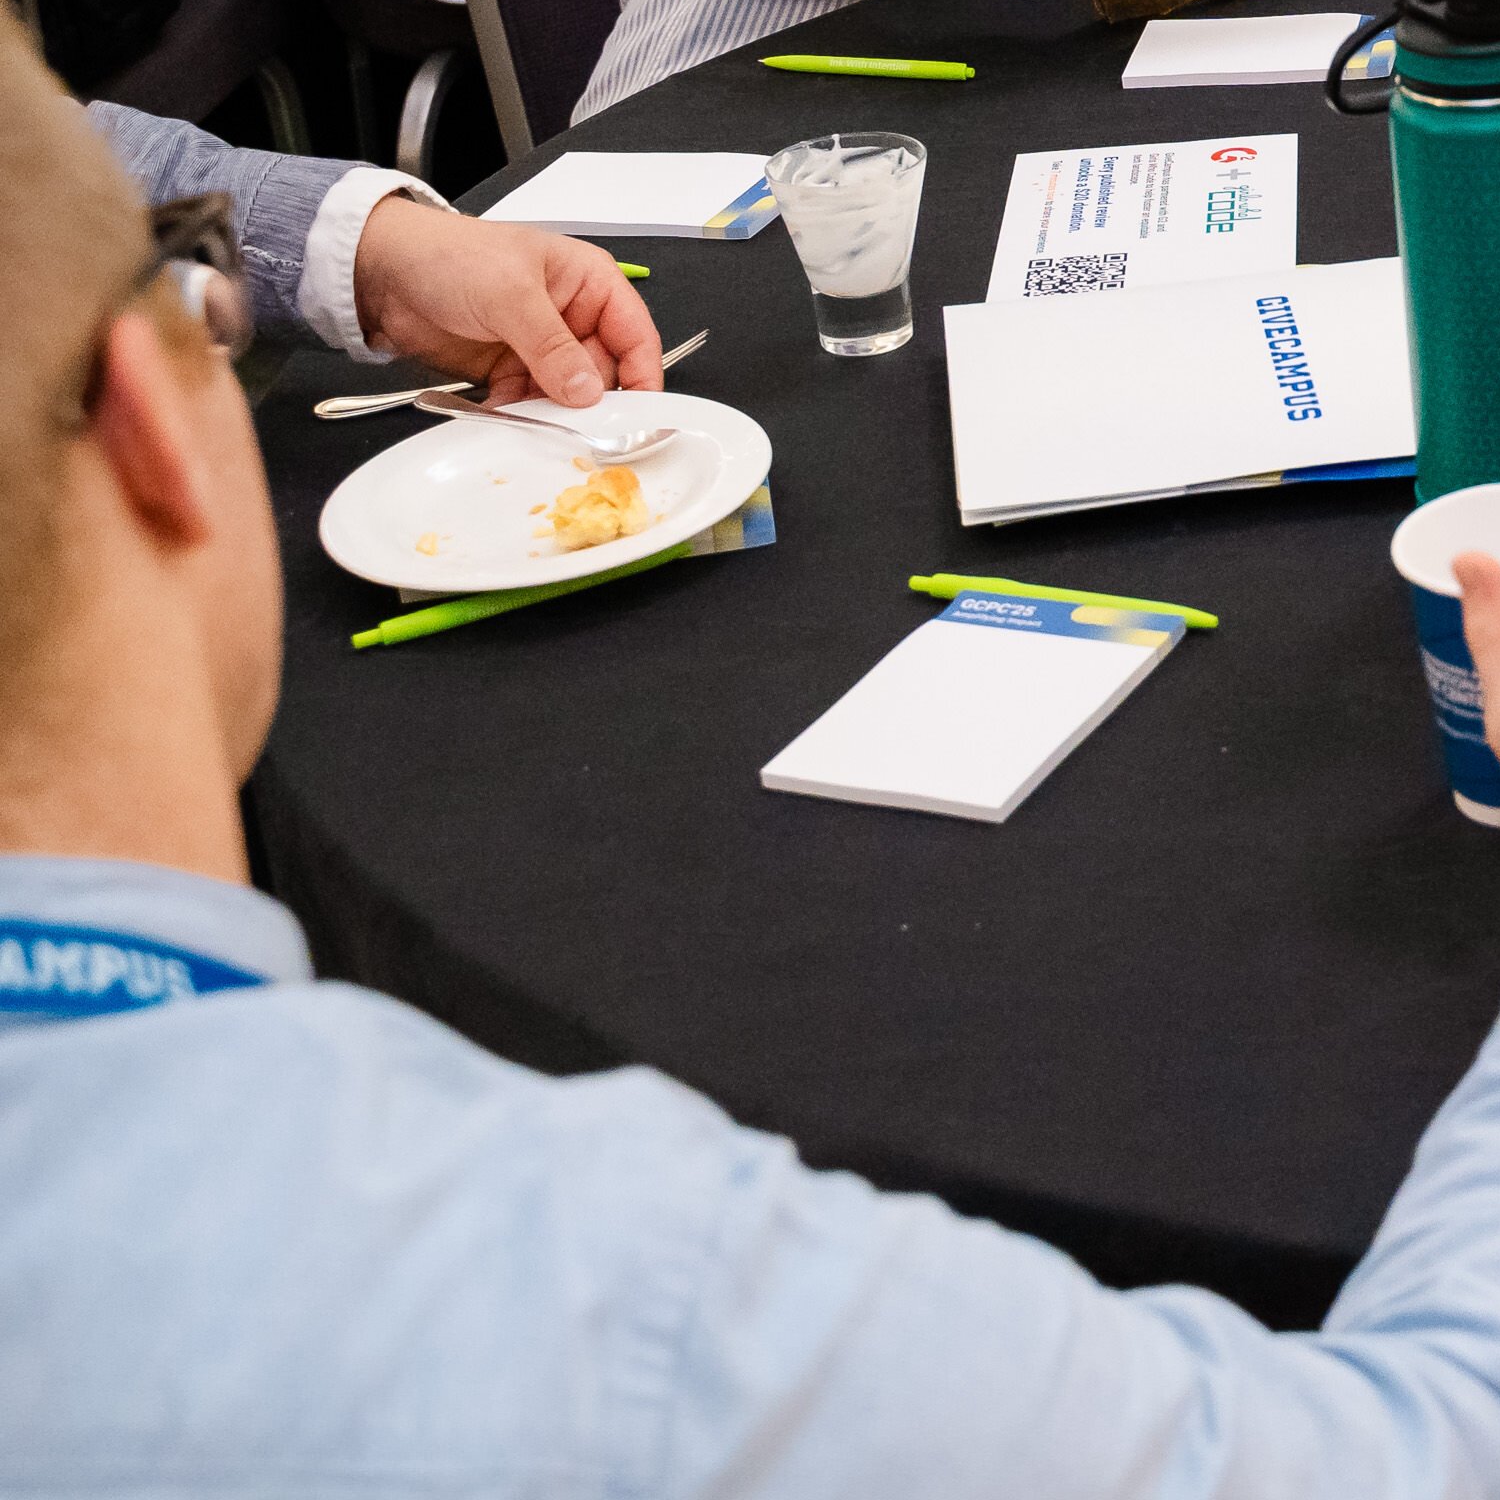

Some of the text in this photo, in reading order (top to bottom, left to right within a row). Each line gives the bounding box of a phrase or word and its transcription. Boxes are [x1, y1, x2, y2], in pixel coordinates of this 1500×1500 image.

[829, 58, 912, 72] Ink With Intention
[1077, 158, 1093, 181] unlocks
[1074, 188, 1090, 201] $20
[1094, 156, 1119, 228] Every published review
[1069, 202, 1087, 233] donation.
[1206, 188, 1261, 234] code
[1256, 296, 1323, 421] GIVECAMPUS
[960, 597, 1038, 617] GCPC'25
